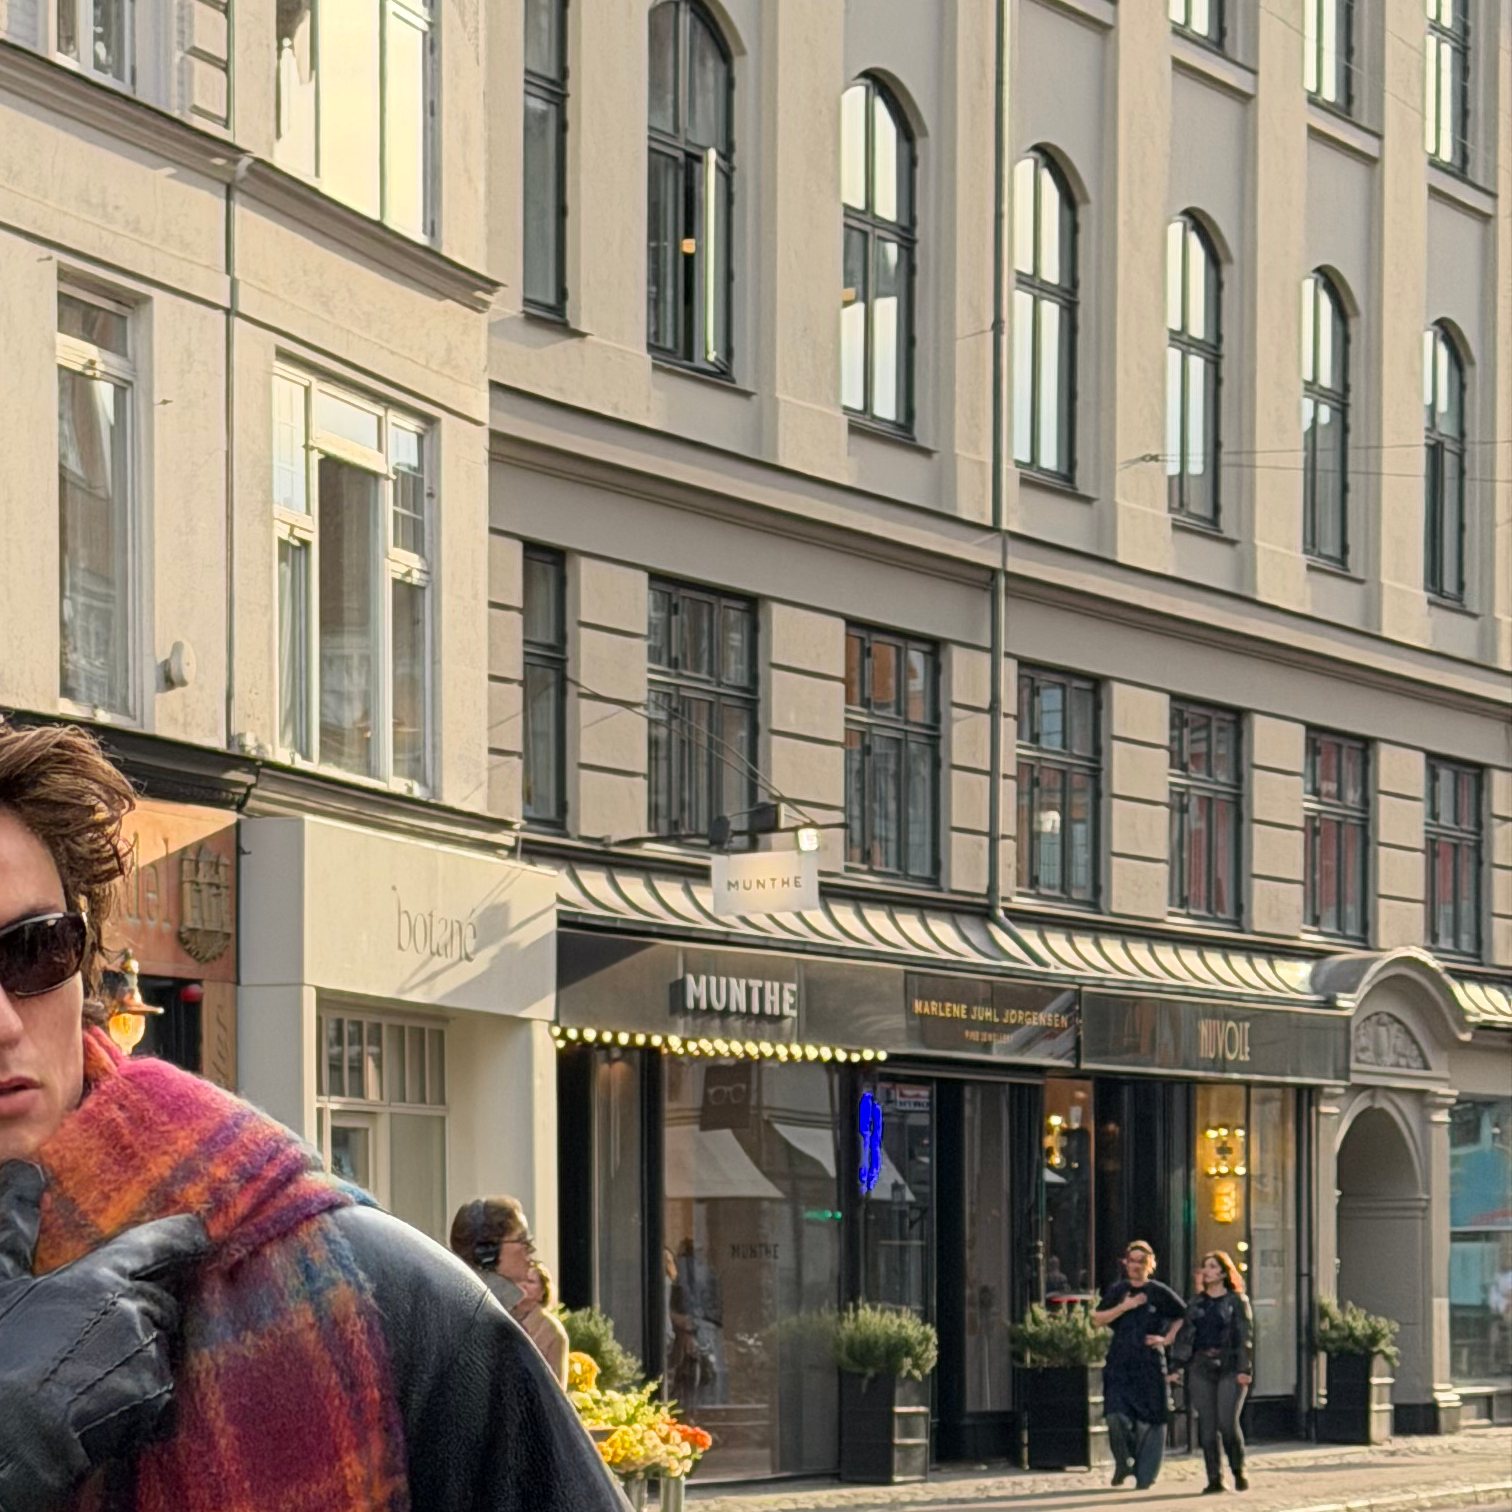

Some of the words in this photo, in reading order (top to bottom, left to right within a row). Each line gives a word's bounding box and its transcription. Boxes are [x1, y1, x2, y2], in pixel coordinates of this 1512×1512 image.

[726, 874, 804, 893] MUNTHE
[390, 884, 477, 963] botané
[685, 974, 799, 1019] MUNTHE
[913, 998, 968, 1020] MARLENE
[970, 1004, 1000, 1023] JUHL
[1002, 1009, 1069, 1030] JØRGENSEN
